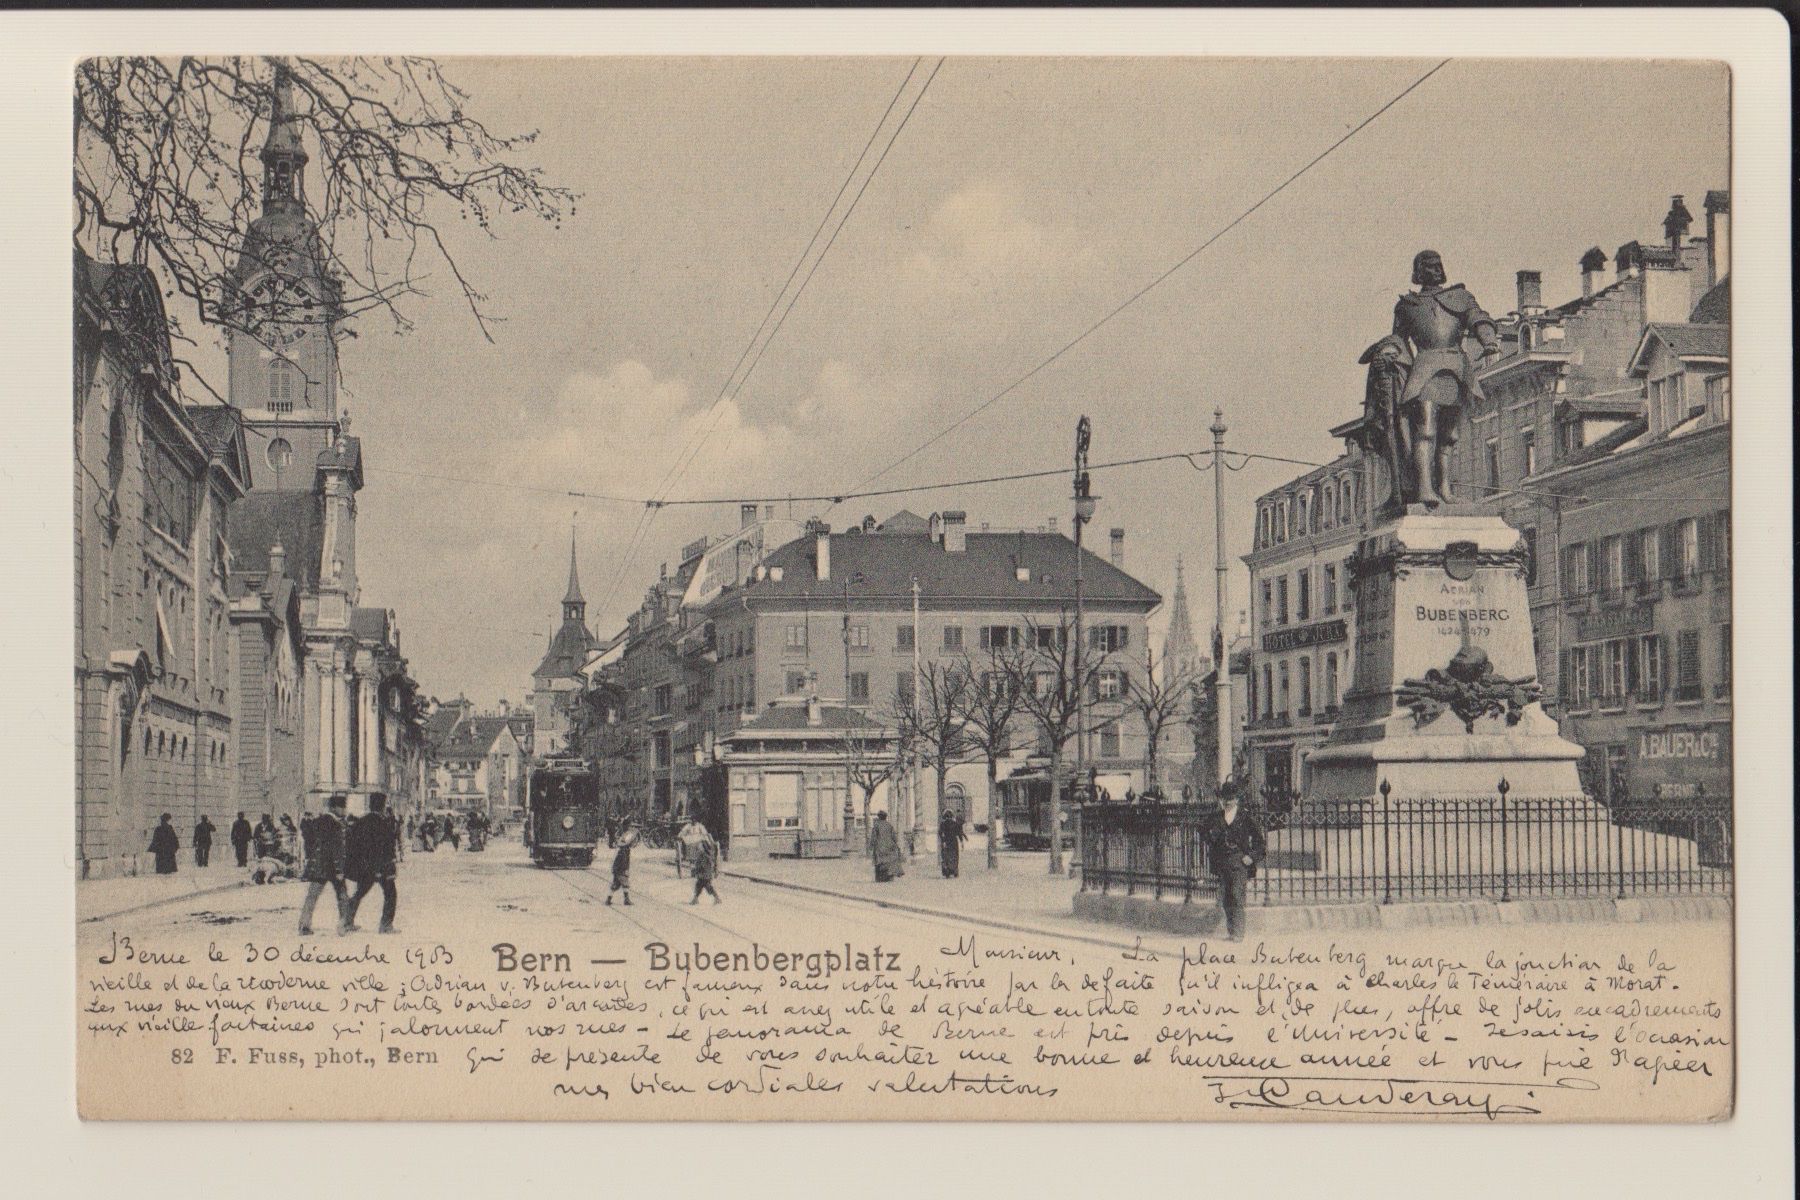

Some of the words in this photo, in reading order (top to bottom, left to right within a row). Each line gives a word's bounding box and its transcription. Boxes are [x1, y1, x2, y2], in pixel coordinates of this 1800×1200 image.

[1416, 606, 1510, 621] BUBENBERG
[1650, 733, 1695, 758] BAUER
[99, 932, 190, 964] Berne
[209, 942, 229, 962] le
[244, 944, 280, 962] 30
[290, 943, 390, 964] décembre
[1180, 943, 1236, 970] place
[1252, 942, 1367, 977] Bubenberg
[1486, 951, 1506, 970] la
[1617, 954, 1634, 974] de
[1648, 949, 1676, 971] la
[186, 976, 207, 990] de
[212, 972, 230, 992] la
[1051, 971, 1071, 991] la
[1337, 976, 1350, 990] à
[1447, 973, 1459, 989] le
[266, 996, 329, 1013] Berne
[1479, 997, 1501, 1017] de
[879, 1022, 904, 1039] de
[696, 1042, 724, 1064] de
